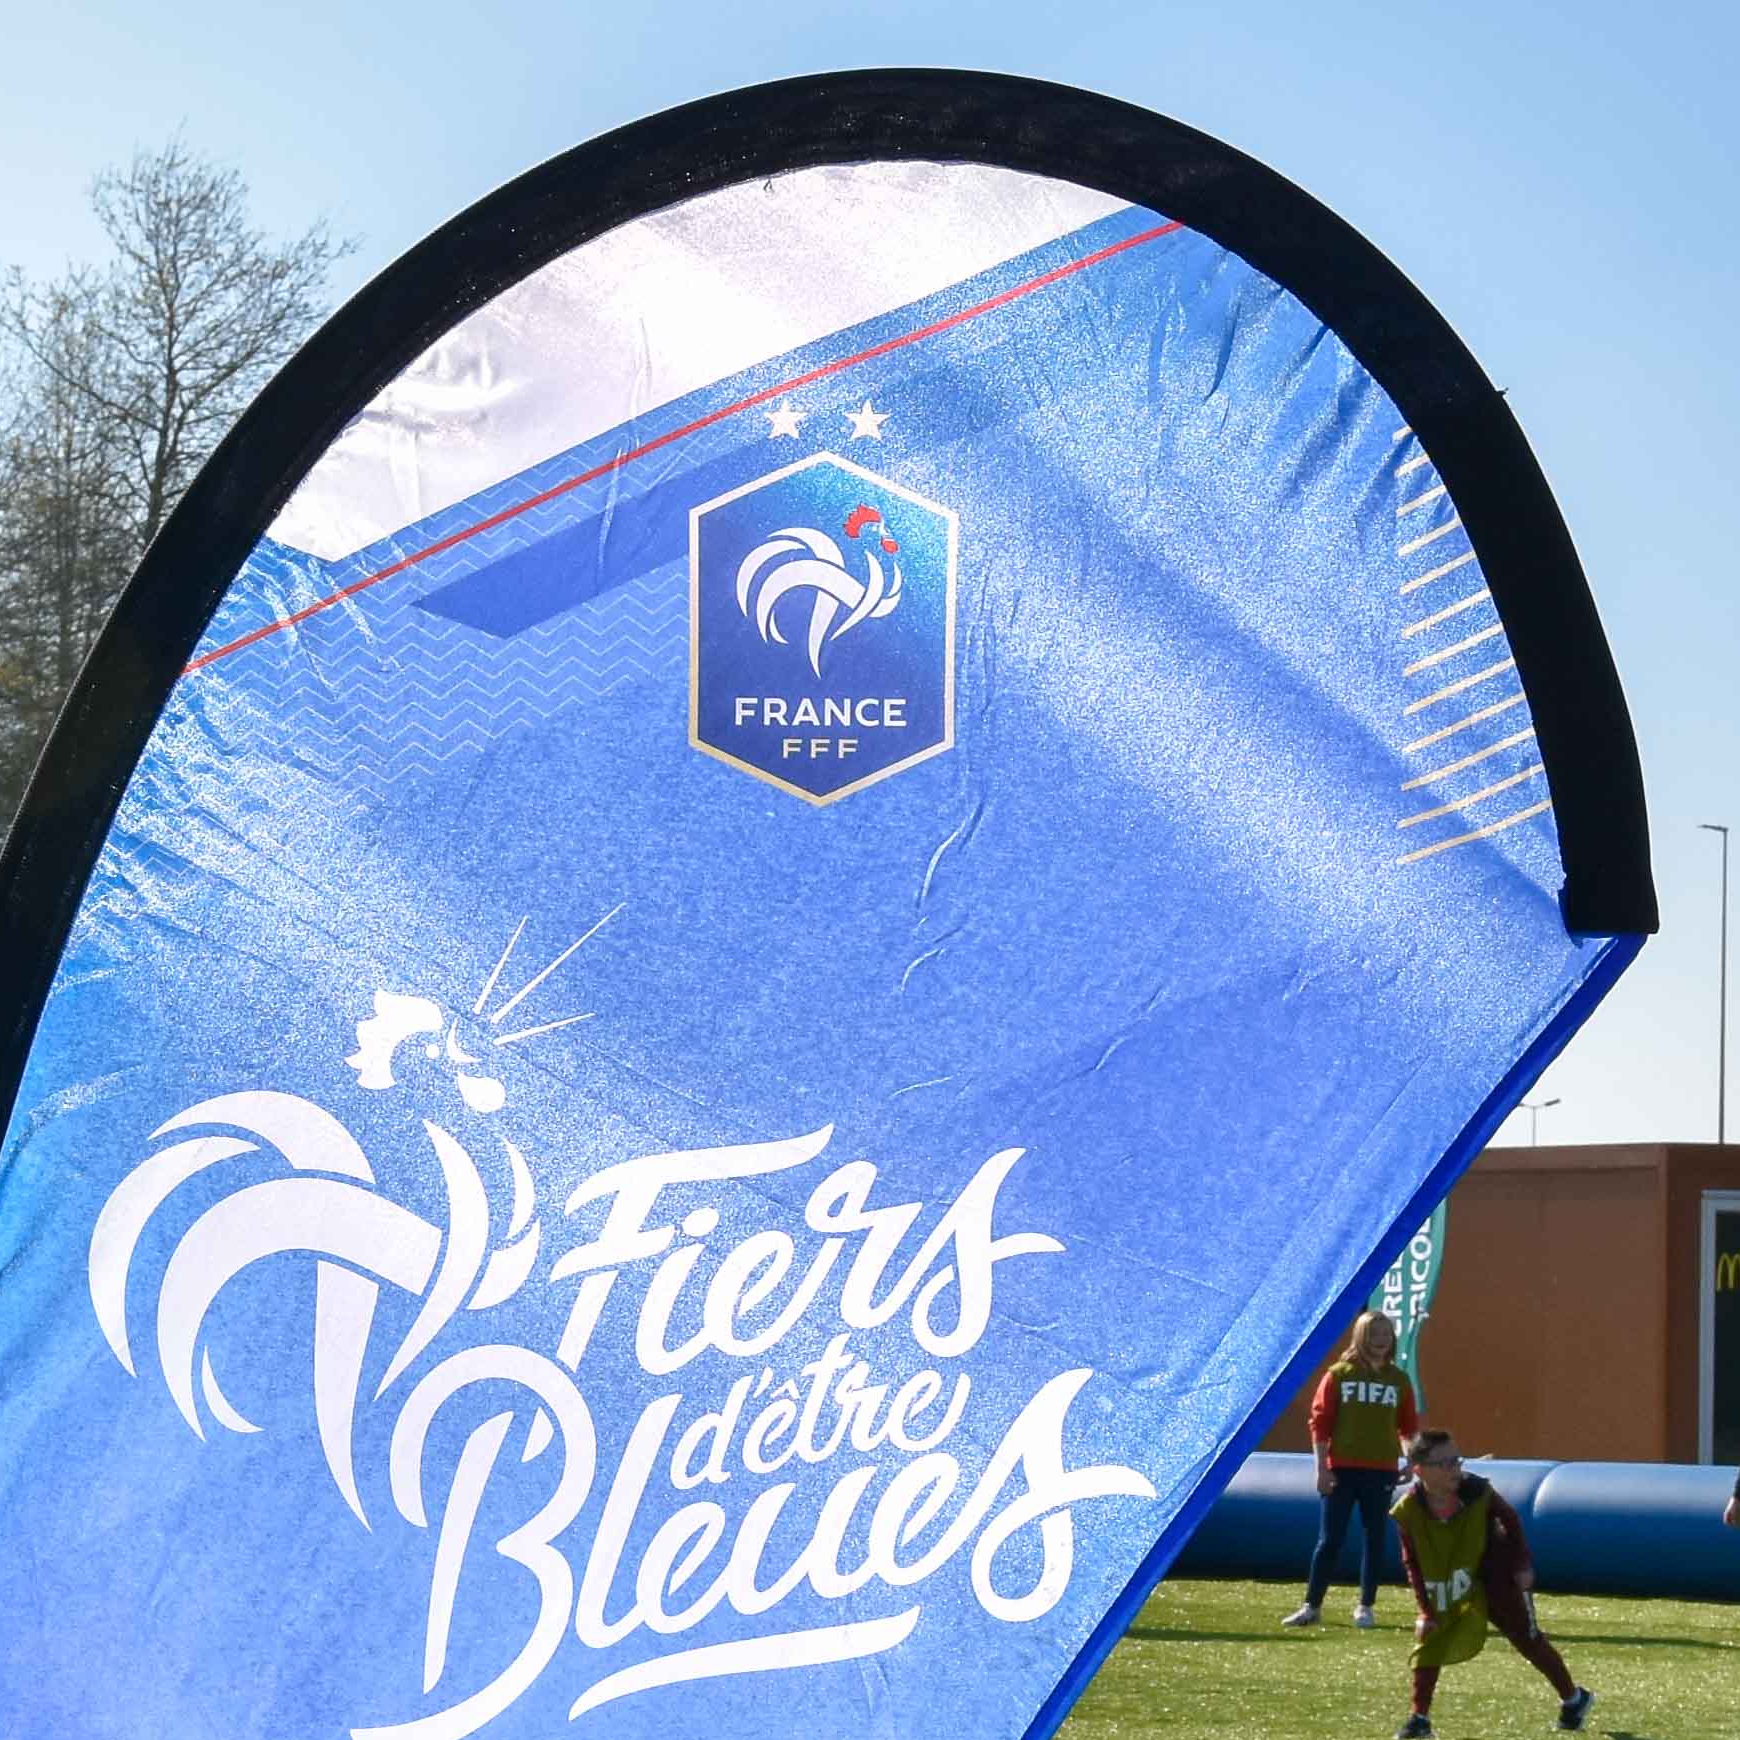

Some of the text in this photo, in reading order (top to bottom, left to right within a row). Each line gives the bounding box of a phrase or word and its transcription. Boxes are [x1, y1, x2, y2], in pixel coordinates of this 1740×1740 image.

[734, 697, 907, 727] FRANCE
[783, 739, 859, 759] FFF
[549, 1122, 1065, 1375] Fiers
[1341, 1382, 1397, 1407] FIFA
[671, 1336, 969, 1488] d'être
